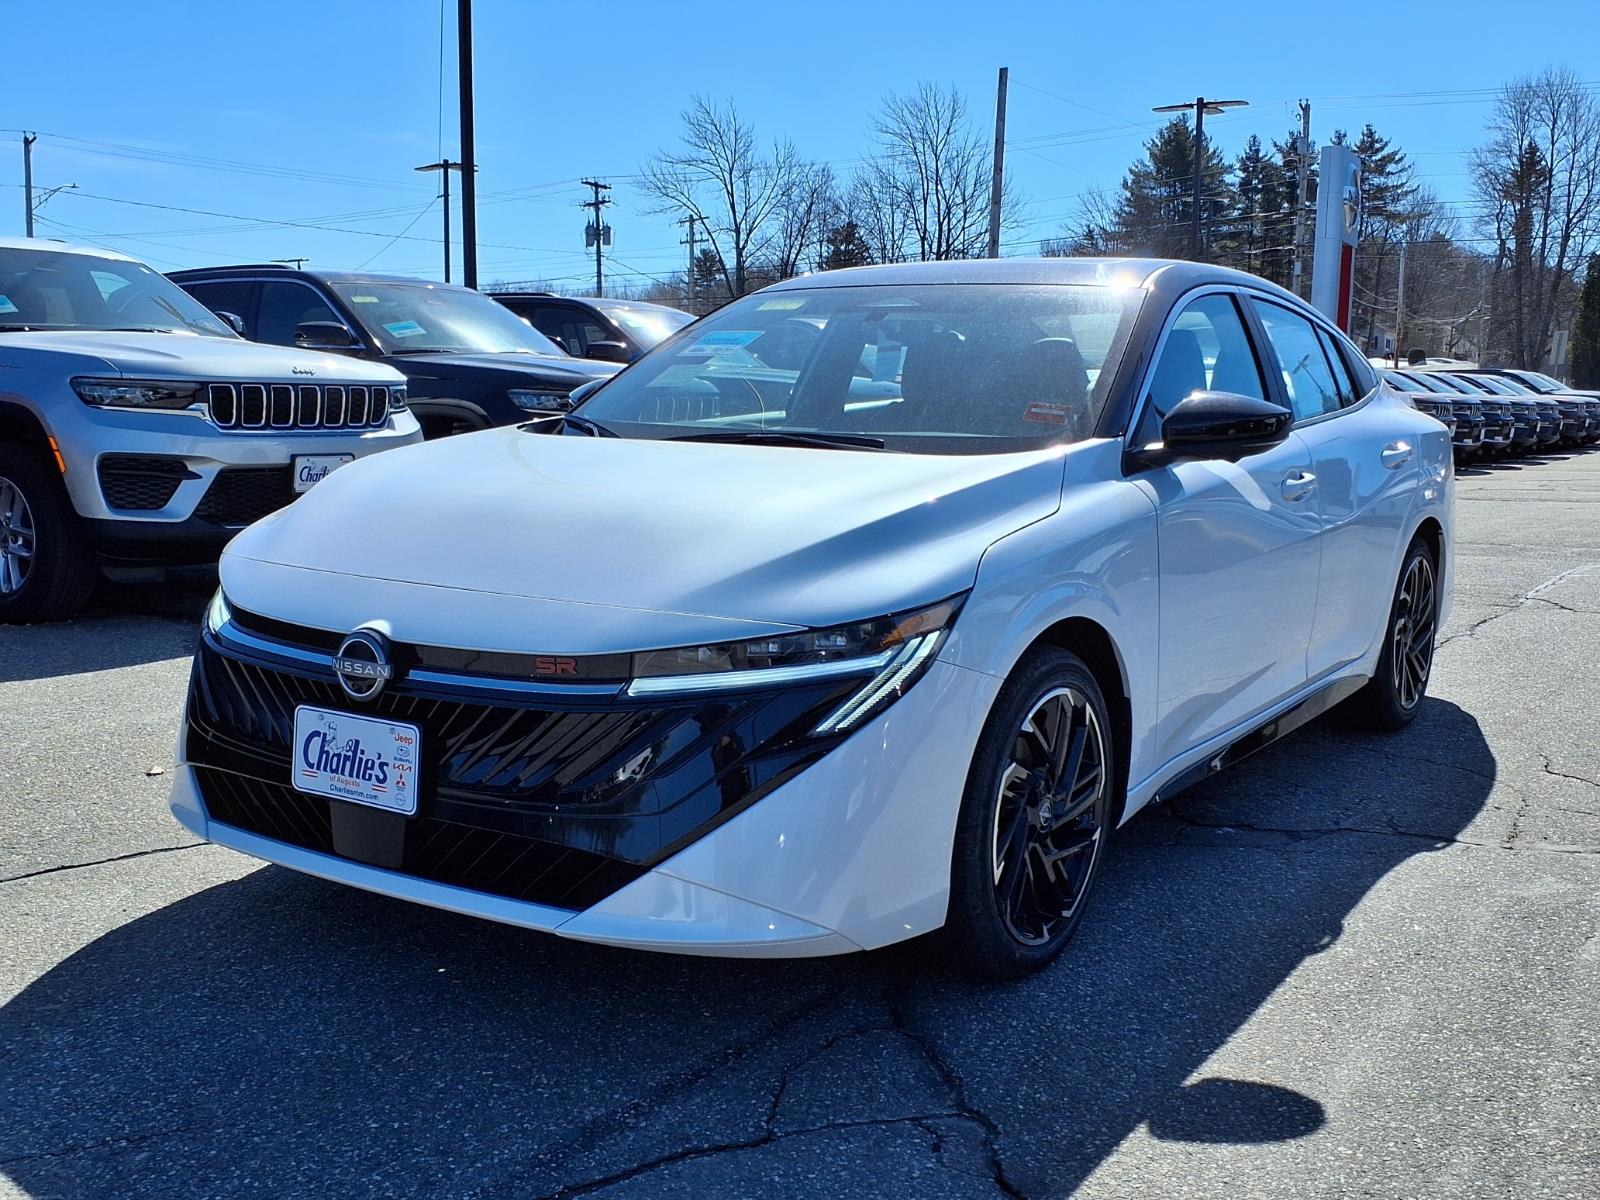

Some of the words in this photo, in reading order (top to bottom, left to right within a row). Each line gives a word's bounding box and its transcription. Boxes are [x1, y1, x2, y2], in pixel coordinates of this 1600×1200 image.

[299, 465, 330, 483] Charl
[332, 658, 388, 677] NISSAN
[536, 657, 577, 674] SR
[394, 733, 413, 746] Jeep
[303, 730, 389, 784] Charlie's
[337, 777, 361, 788] Augusta
[329, 784, 379, 801] Charliesmm.com
